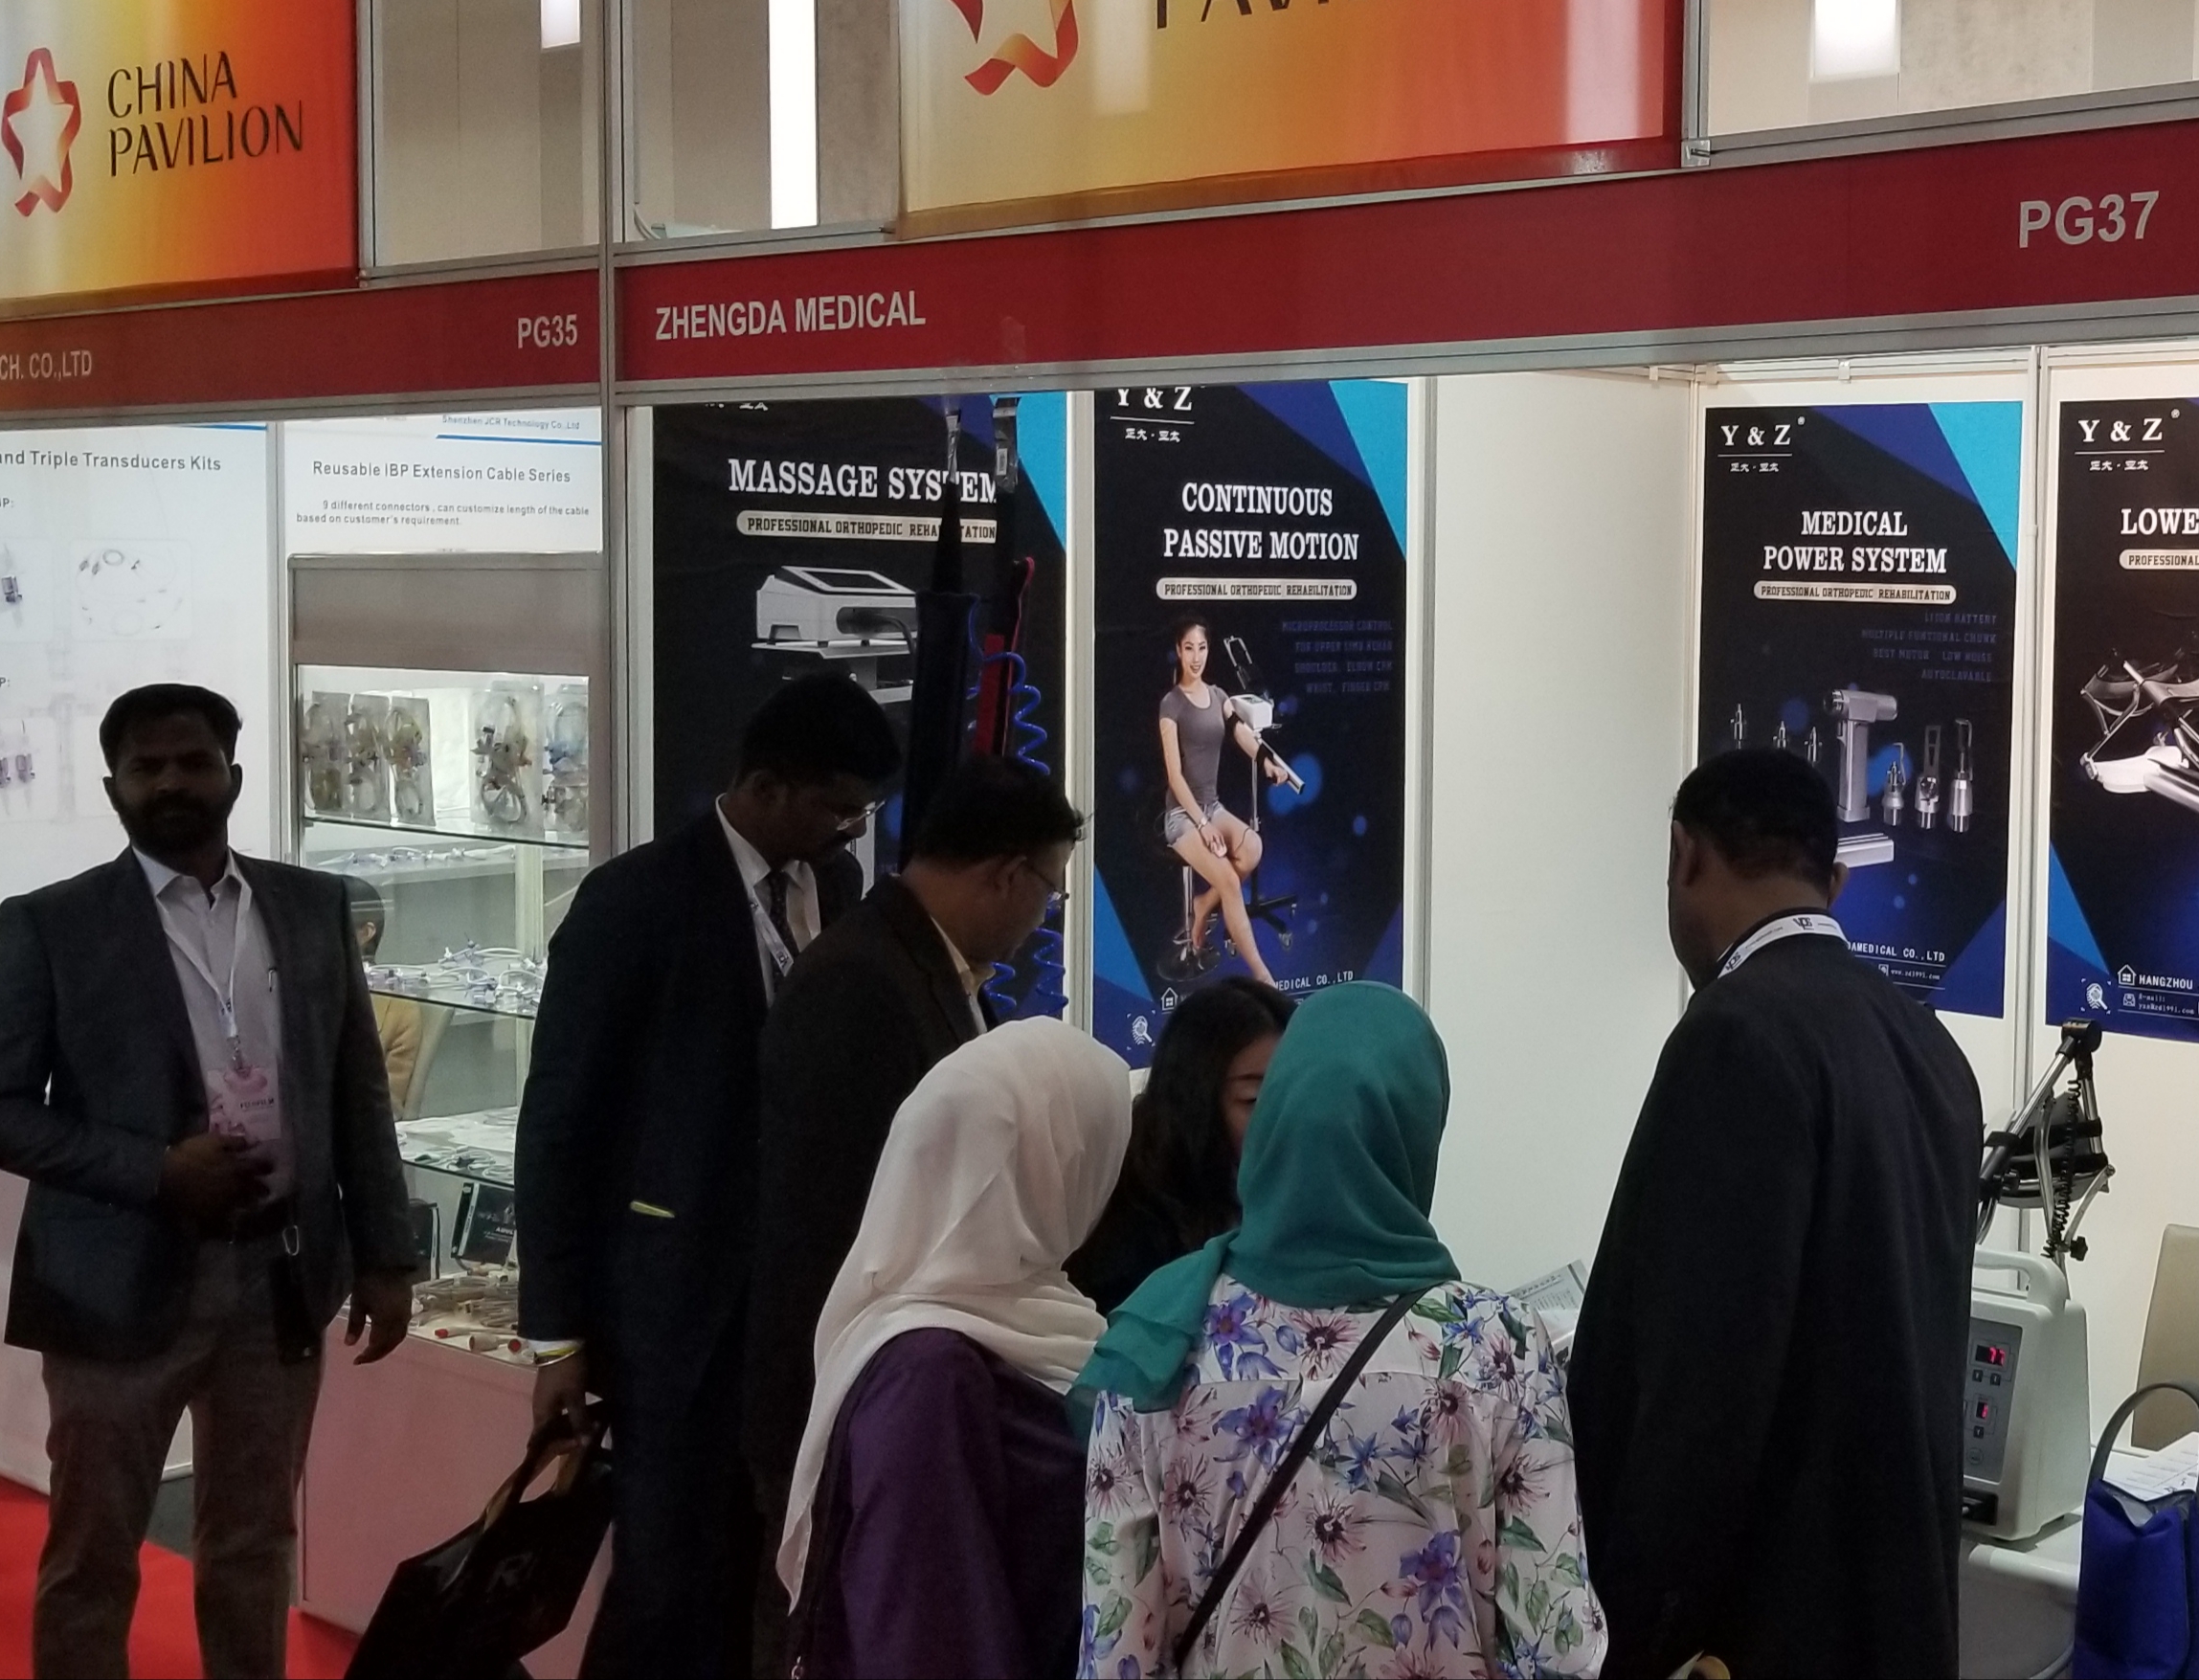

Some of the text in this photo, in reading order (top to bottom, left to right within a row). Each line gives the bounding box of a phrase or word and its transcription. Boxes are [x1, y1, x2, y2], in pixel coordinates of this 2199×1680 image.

[107, 51, 238, 119] CHINA
[109, 100, 304, 177] PAVILION
[2018, 190, 2160, 249] PG37
[655, 290, 927, 341] ZHENGDA MEDICAL
[516, 314, 578, 349] PG35
[29, 349, 93, 382] CO.,LTD
[1173, 386, 1193, 412] Z
[504, 417, 549, 430] Technology
[1720, 424, 1791, 446] Y & Z
[2077, 417, 2163, 442] Y & Z
[30, 450, 79, 470] Triple
[81, 452, 186, 470] Transducers
[190, 455, 222, 472] Kits
[313, 460, 571, 483] Reusable IBP Extension Cable Series
[728, 459, 879, 499] MASSAGE
[323, 500, 328, 510] 9
[330, 500, 373, 510] different
[375, 503, 430, 512] connectors
[438, 504, 455, 513] can
[457, 504, 505, 514] customize
[506, 504, 536, 516] length
[537, 505, 548, 515] of
[549, 505, 563, 515] the
[565, 505, 590, 516] cable
[1181, 482, 1334, 516] CONTINUOUS
[296, 513, 326, 523] based
[344, 514, 398, 525] customer's
[747, 518, 996, 540] PROFESSIONAL ORTHOPEDIC REHAATION
[1801, 510, 1908, 536] MEDICAL
[2120, 507, 2199, 535] LOWE
[1163, 528, 1359, 560] PASSIVE MOTION
[1762, 545, 1948, 573] POWER SYSTEM
[2128, 554, 2199, 566] PROFESSIONAL
[1164, 583, 1353, 597] PROFESSIONAL ORTHOPEDIC REHABILITATION
[1761, 585, 1951, 601] PROFESSIONAL ORTHOPEDIC REHABILITATION
[2138, 974, 2193, 991] HANGZHOU
